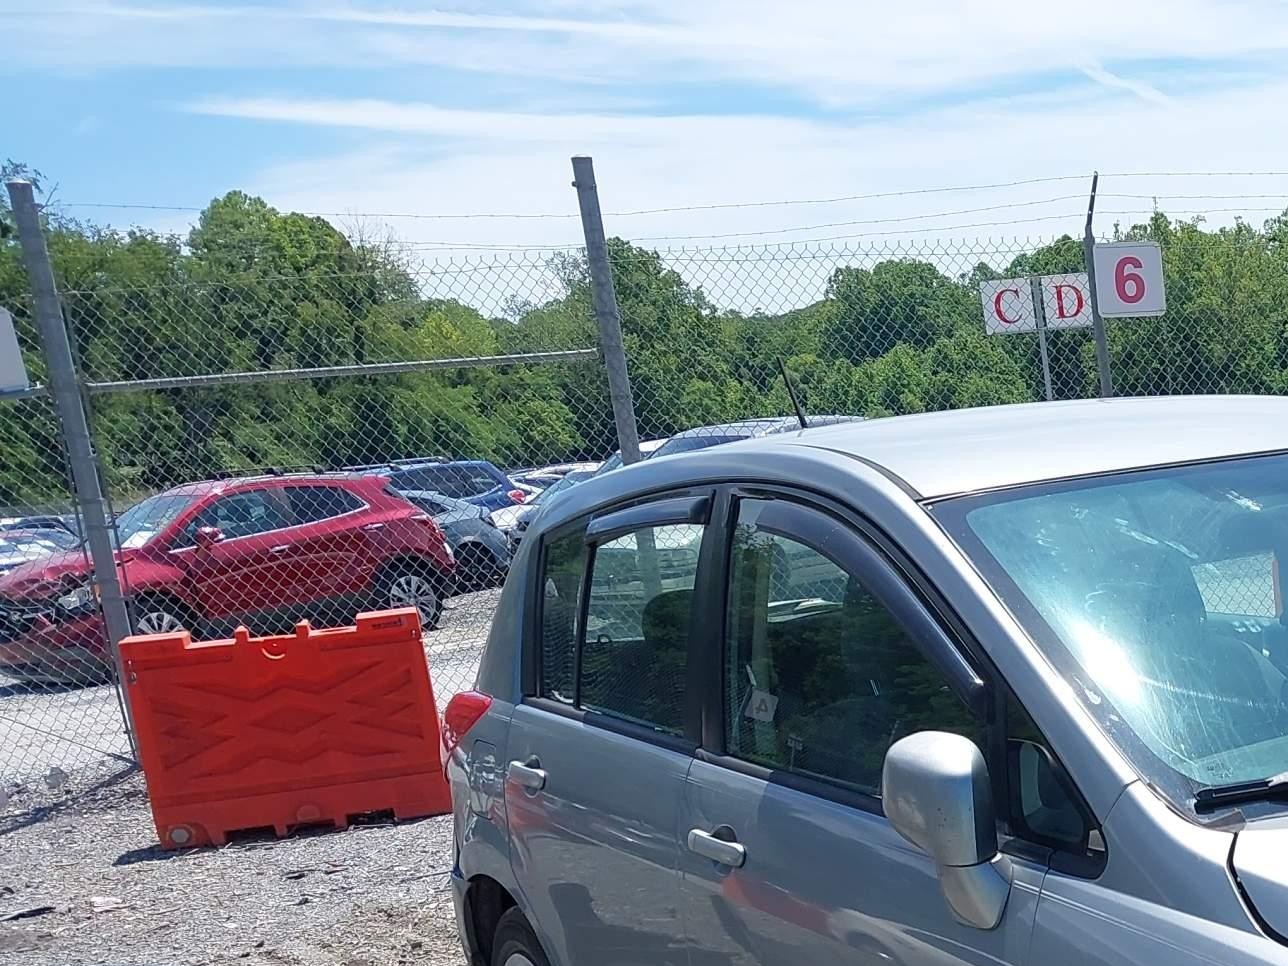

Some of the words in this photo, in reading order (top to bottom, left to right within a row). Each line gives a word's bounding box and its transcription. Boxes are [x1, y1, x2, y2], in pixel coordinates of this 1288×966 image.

[1114, 254, 1147, 304] 6
[993, 287, 1023, 325] C
[1051, 283, 1085, 320] D
